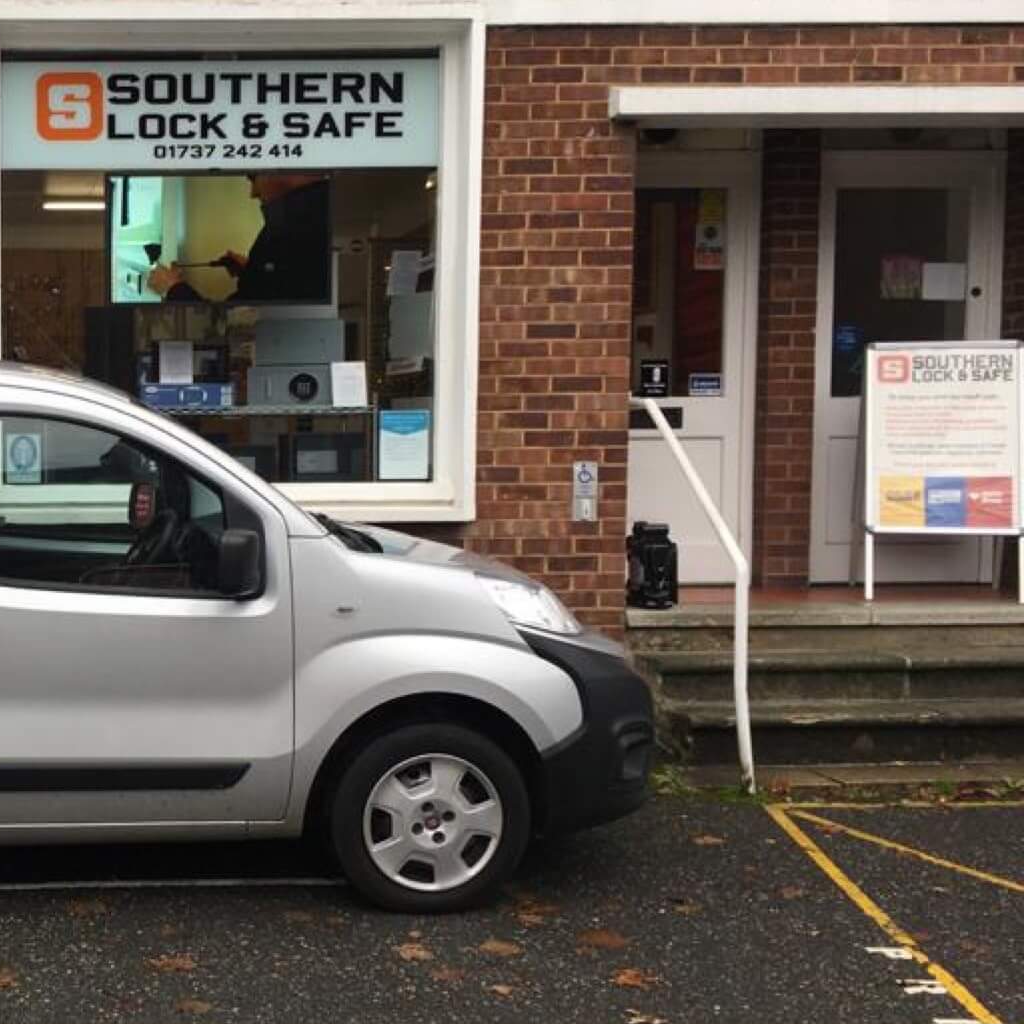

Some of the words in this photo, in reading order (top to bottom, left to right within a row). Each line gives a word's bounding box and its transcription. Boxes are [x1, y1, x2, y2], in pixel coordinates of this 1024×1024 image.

[107, 72, 404, 104] SOUTHERN
[107, 112, 227, 139] LOCK
[242, 112, 269, 139] &
[282, 112, 404, 138] SAFE
[153, 144, 216, 160] 01737
[223, 144, 262, 159] 242
[268, 143, 303, 158] 414
[912, 354, 1014, 370] SOUTHERN
[912, 370, 953, 383] LOCK
[972, 368, 1014, 381] SAFE
